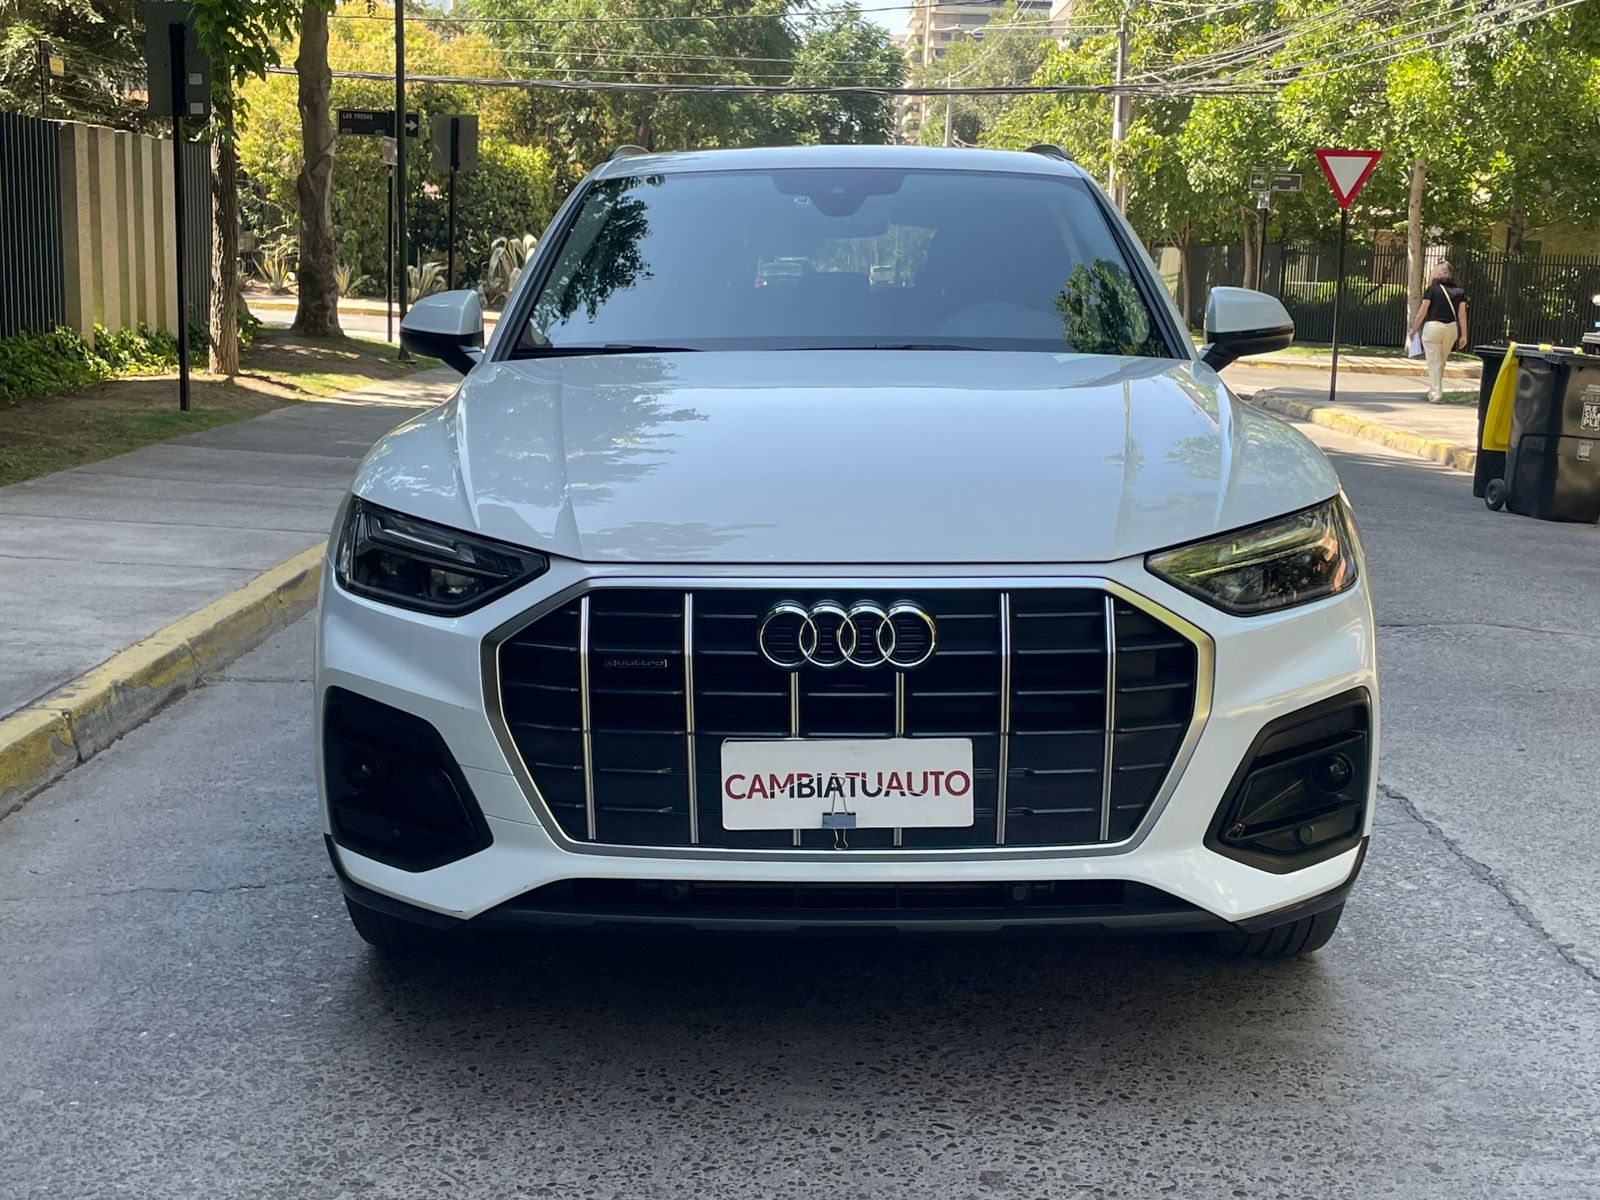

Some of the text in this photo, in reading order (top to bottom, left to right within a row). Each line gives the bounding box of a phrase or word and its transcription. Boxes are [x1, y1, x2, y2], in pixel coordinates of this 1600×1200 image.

[1585, 405, 1598, 413] RE
[1584, 412, 1600, 421] SIM
[1583, 419, 1599, 427] PLE
[606, 658, 665, 668] quattro
[724, 770, 971, 800] CAMBIATUAUTO
